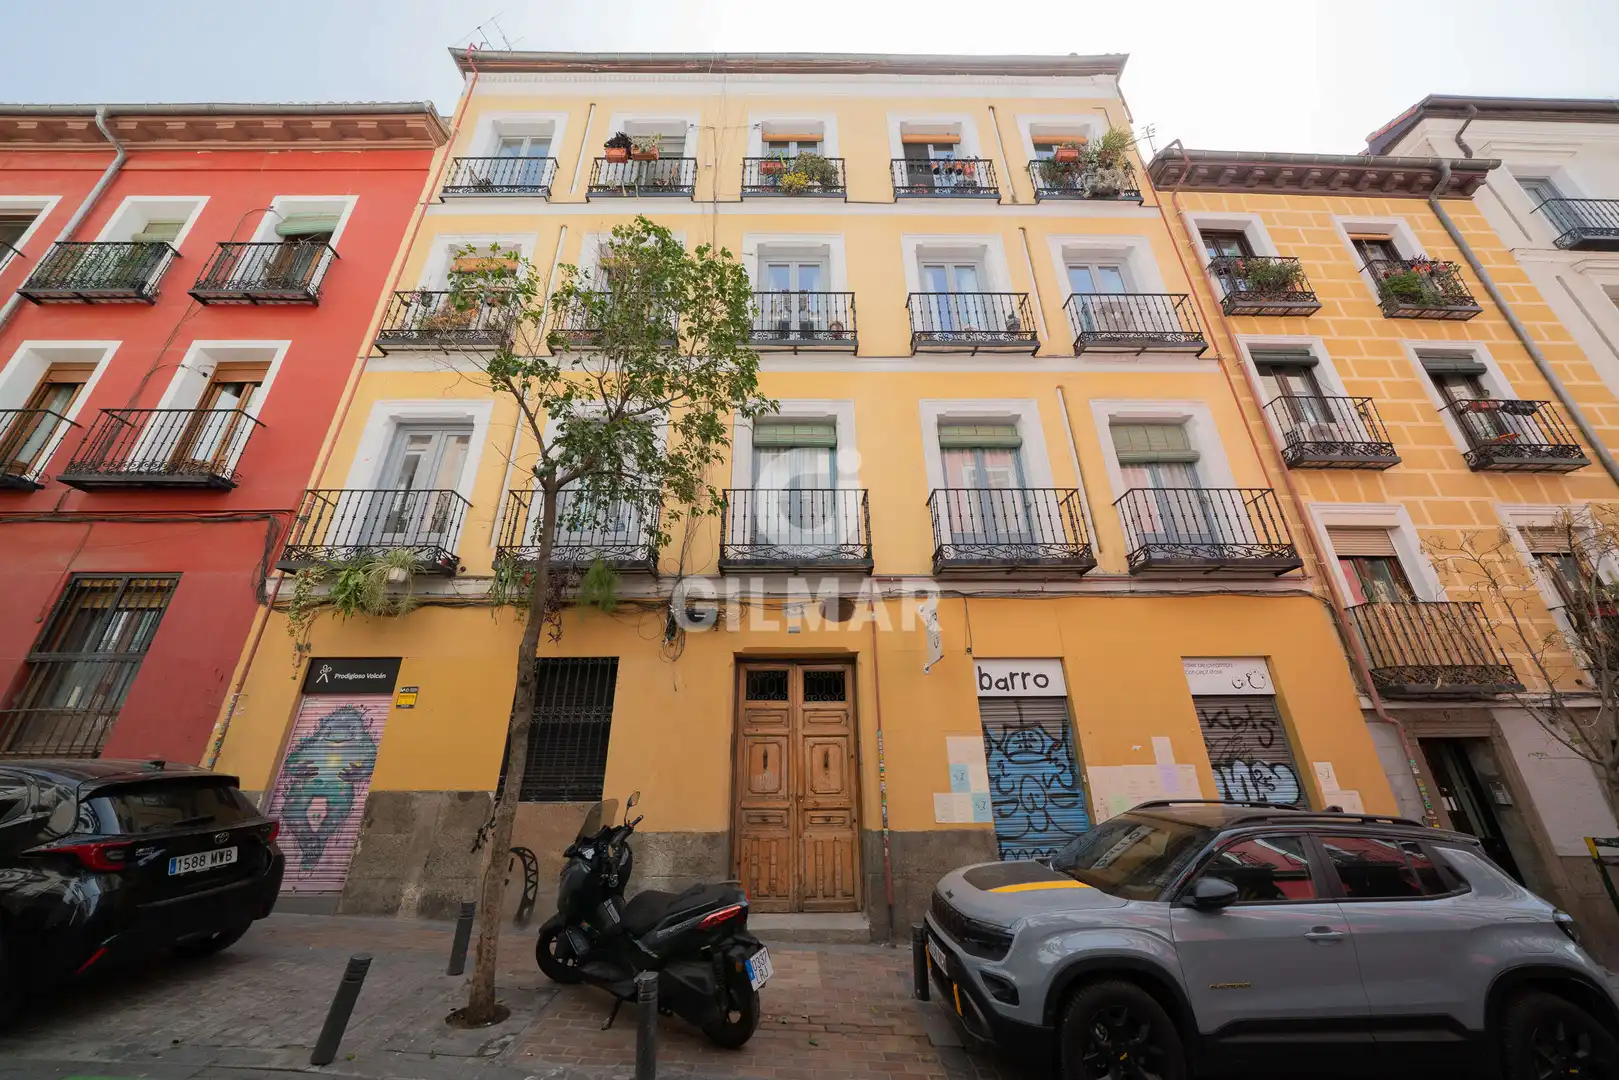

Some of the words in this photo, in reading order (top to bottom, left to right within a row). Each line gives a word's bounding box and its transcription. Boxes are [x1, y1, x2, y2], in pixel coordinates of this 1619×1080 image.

[334, 672, 365, 680] Prodigioso
[977, 665, 1049, 691] barro
[177, 856, 206, 871] 1588
[210, 850, 233, 864] MWB
[751, 950, 767, 972] 0337
[754, 964, 769, 985] LRJ
